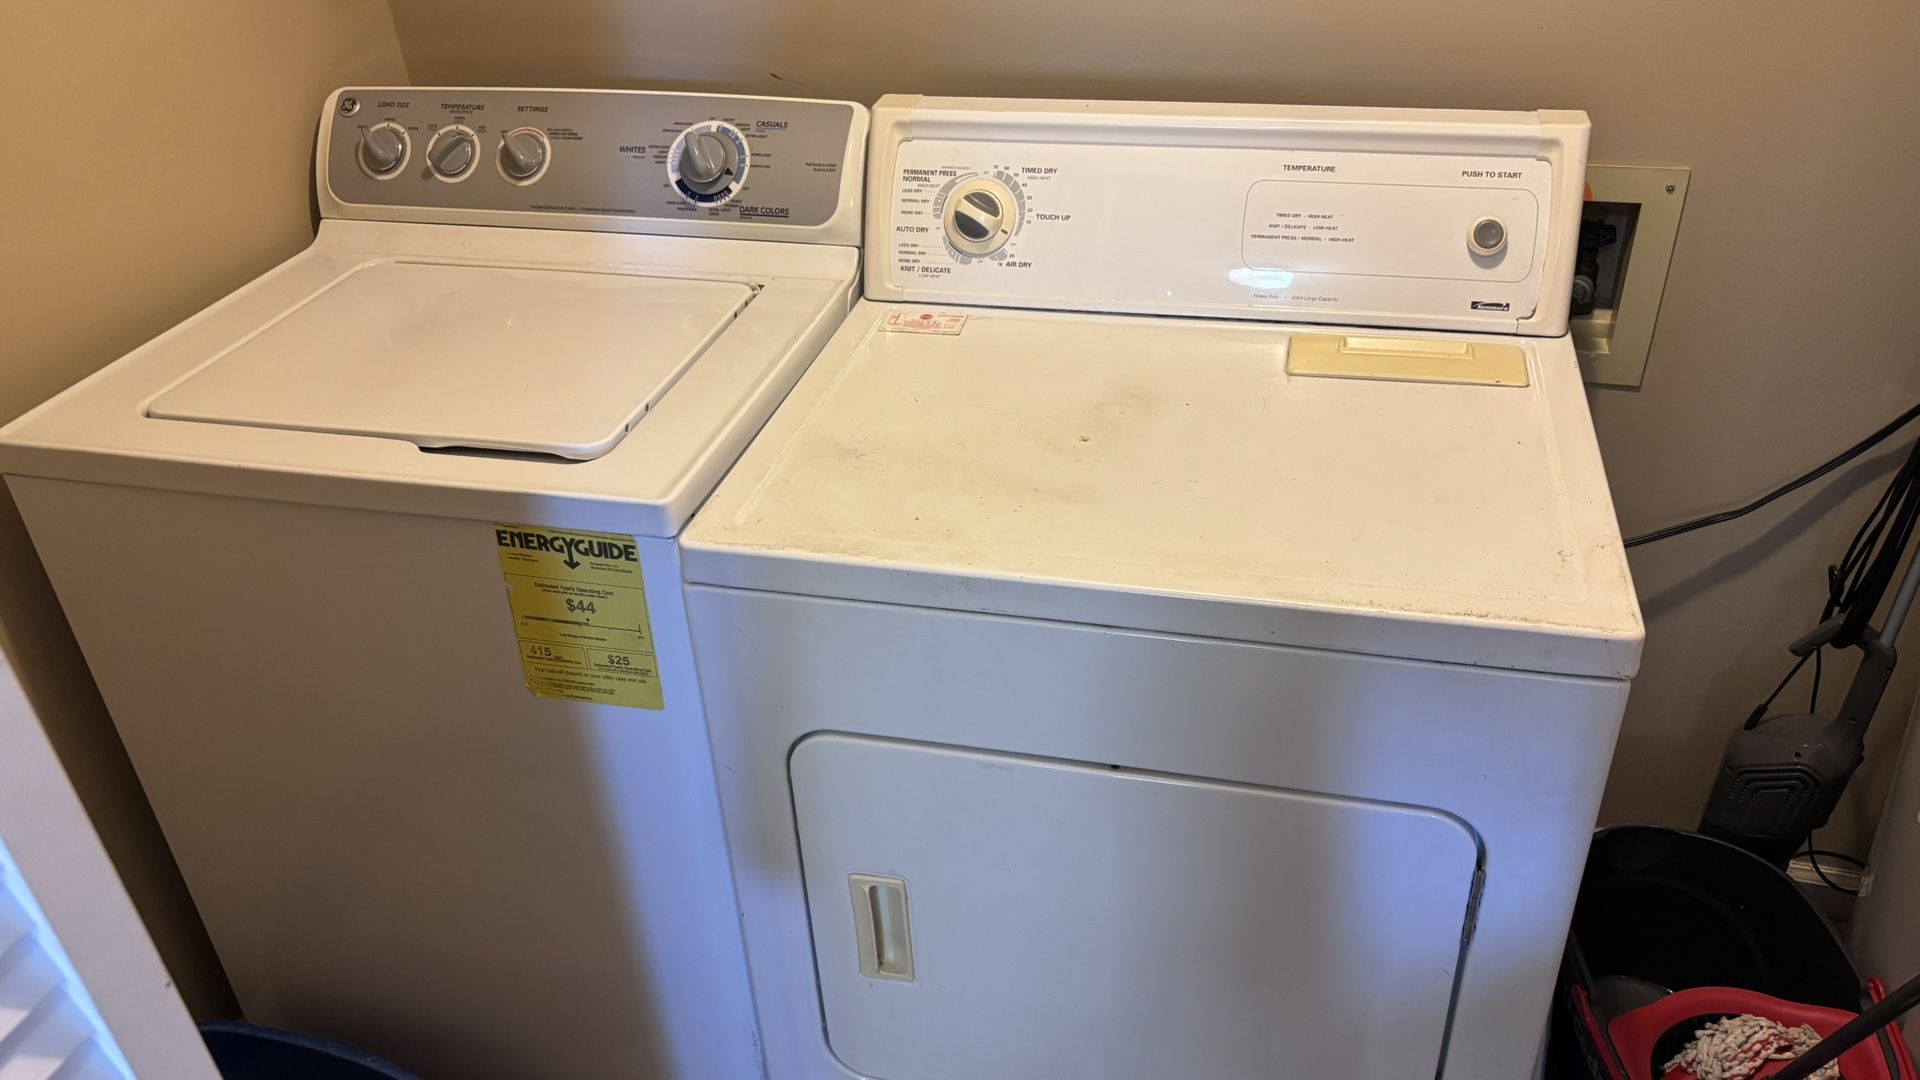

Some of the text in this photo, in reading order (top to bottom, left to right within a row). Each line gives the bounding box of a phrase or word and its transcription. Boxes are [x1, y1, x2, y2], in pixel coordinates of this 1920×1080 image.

[619, 146, 646, 154] WHITES
[1282, 164, 1336, 172] TEMPERATURE
[496, 529, 638, 565] ENERGYGUIDE
[534, 582, 559, 590] Estimated
[576, 587, 600, 595] Operating
[566, 598, 596, 614] $44
[530, 645, 552, 656] 415
[608, 654, 630, 666] $25
